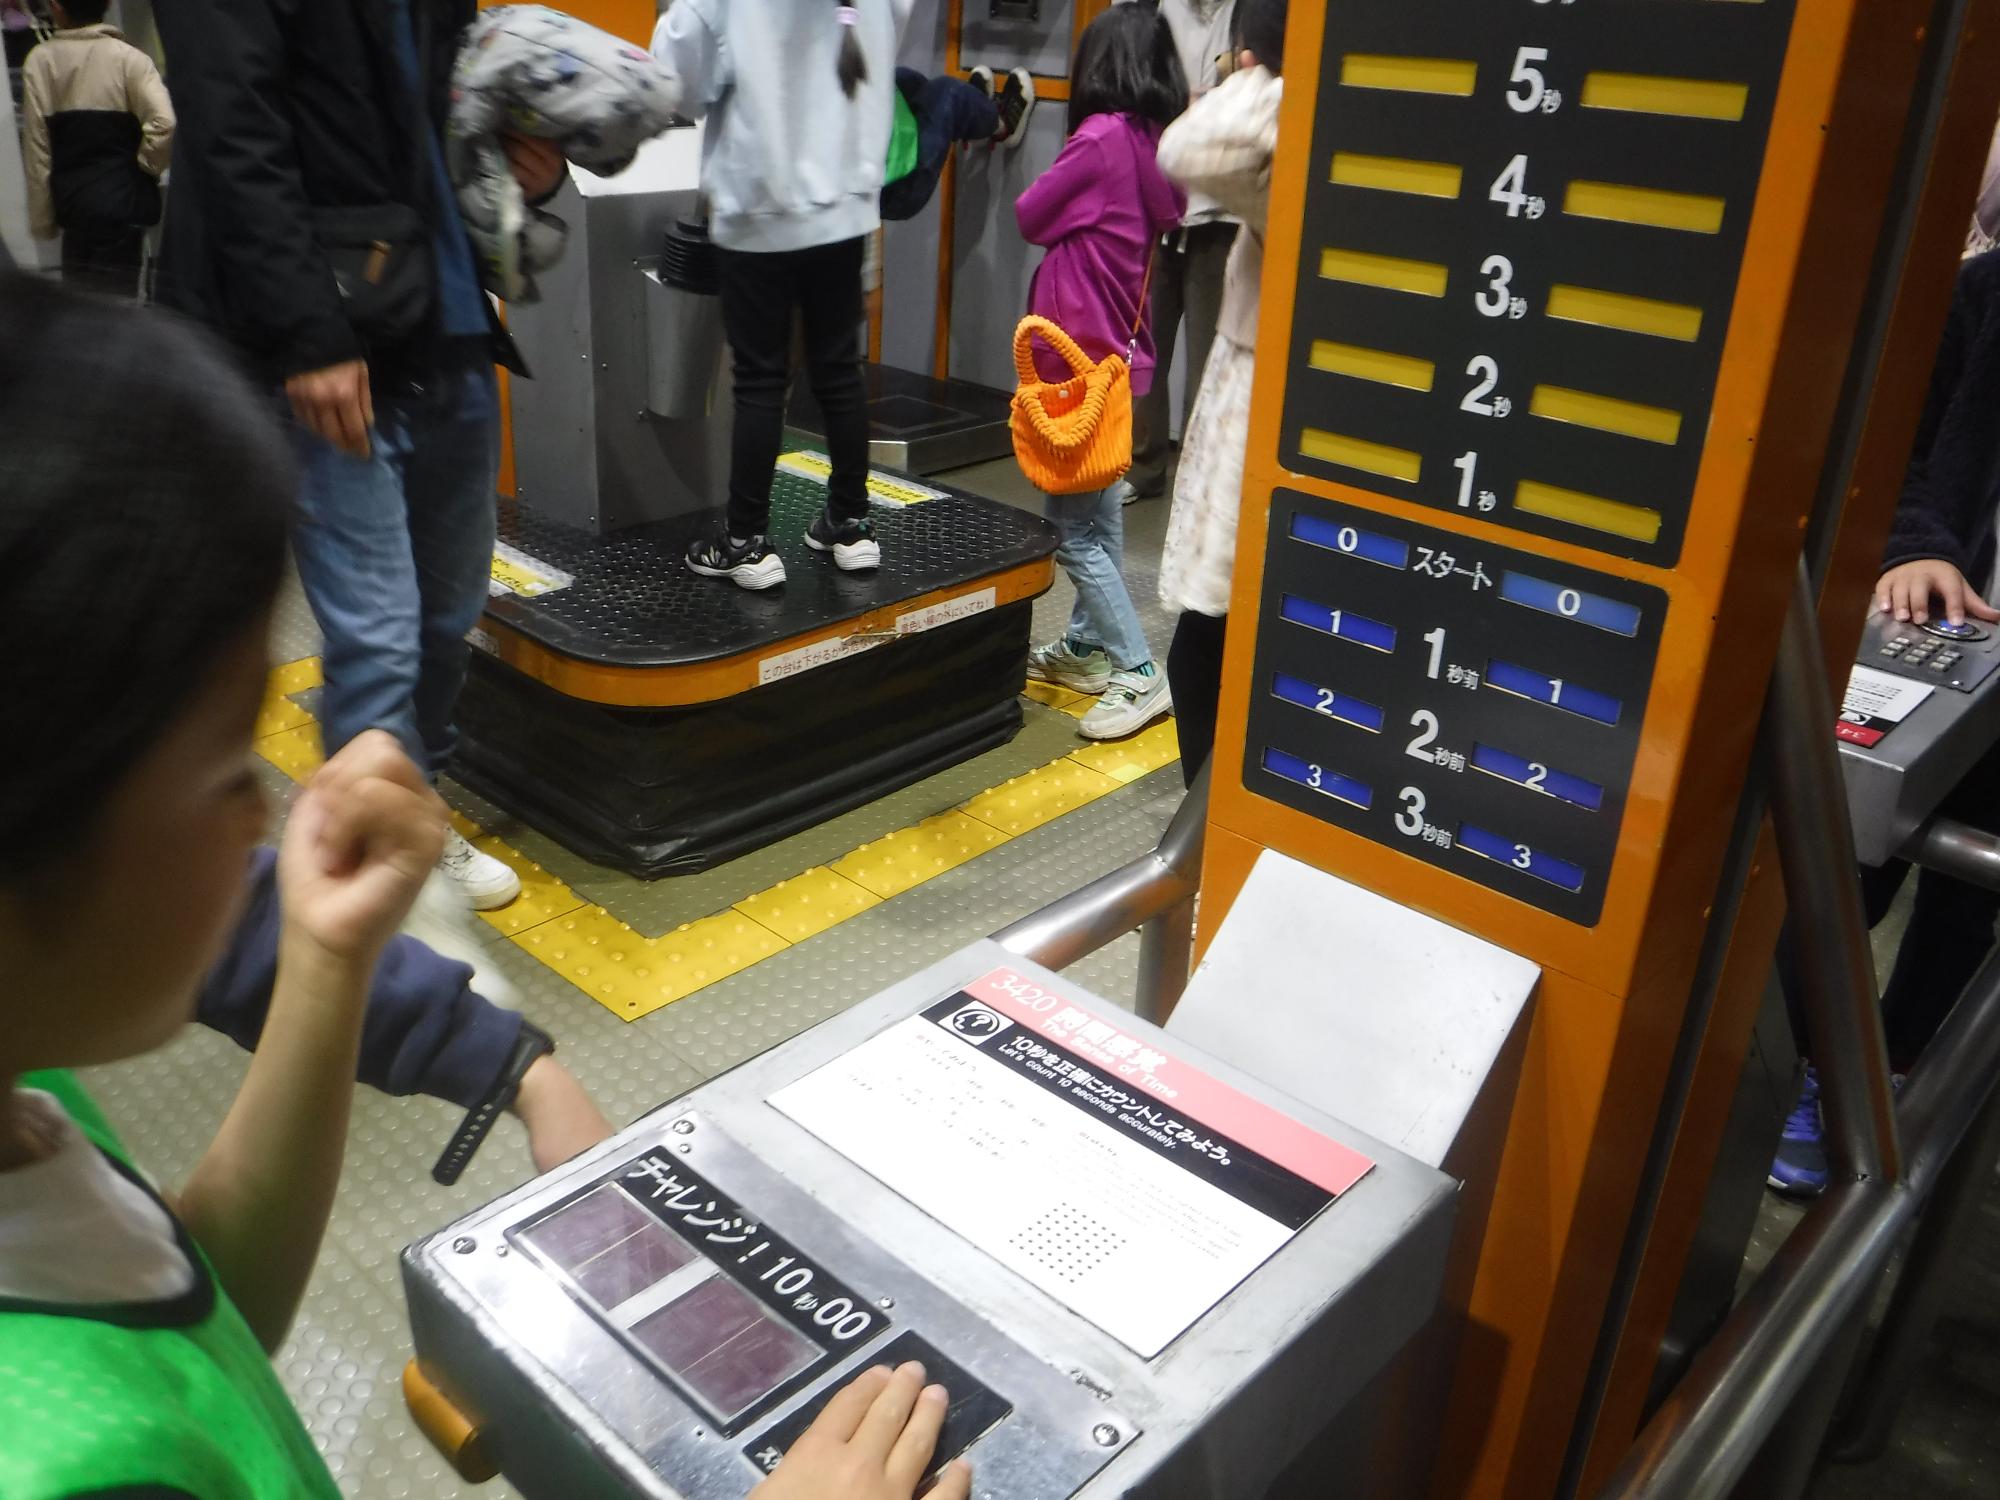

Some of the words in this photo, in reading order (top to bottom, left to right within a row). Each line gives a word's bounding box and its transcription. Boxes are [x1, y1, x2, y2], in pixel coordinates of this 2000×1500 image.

[1505, 46, 1562, 114] 5秒
[1489, 153, 1546, 220] 4秒
[1474, 254, 1527, 320] 3秒
[1459, 355, 1512, 418] 2秒
[1453, 451, 1496, 512] 1秒
[1337, 526, 1358, 553] 0
[1412, 546, 1492, 590] スタート
[1329, 610, 1343, 634] 1
[1556, 589, 1581, 617] 0
[1423, 627, 1480, 690] 1秒前
[1316, 688, 1335, 715] 2
[1548, 678, 1564, 704] 1
[1405, 710, 1466, 773] 2秒前
[1306, 764, 1322, 788] 3
[1525, 763, 1547, 791] 2
[1394, 786, 1452, 849] 3秒前
[1512, 844, 1532, 869] 3
[991, 974, 1057, 1012] 3420
[1025, 1059, 1055, 1080] count
[1057, 1076, 1071, 1088] 10
[1071, 1085, 1117, 1115] seconds
[1041, 1019, 1069, 1039] The
[1118, 1063, 1135, 1075] of
[1142, 1073, 1180, 1099] Time
[1009, 1035, 1231, 1165] 10秒を正確にカウントしてみよう。
